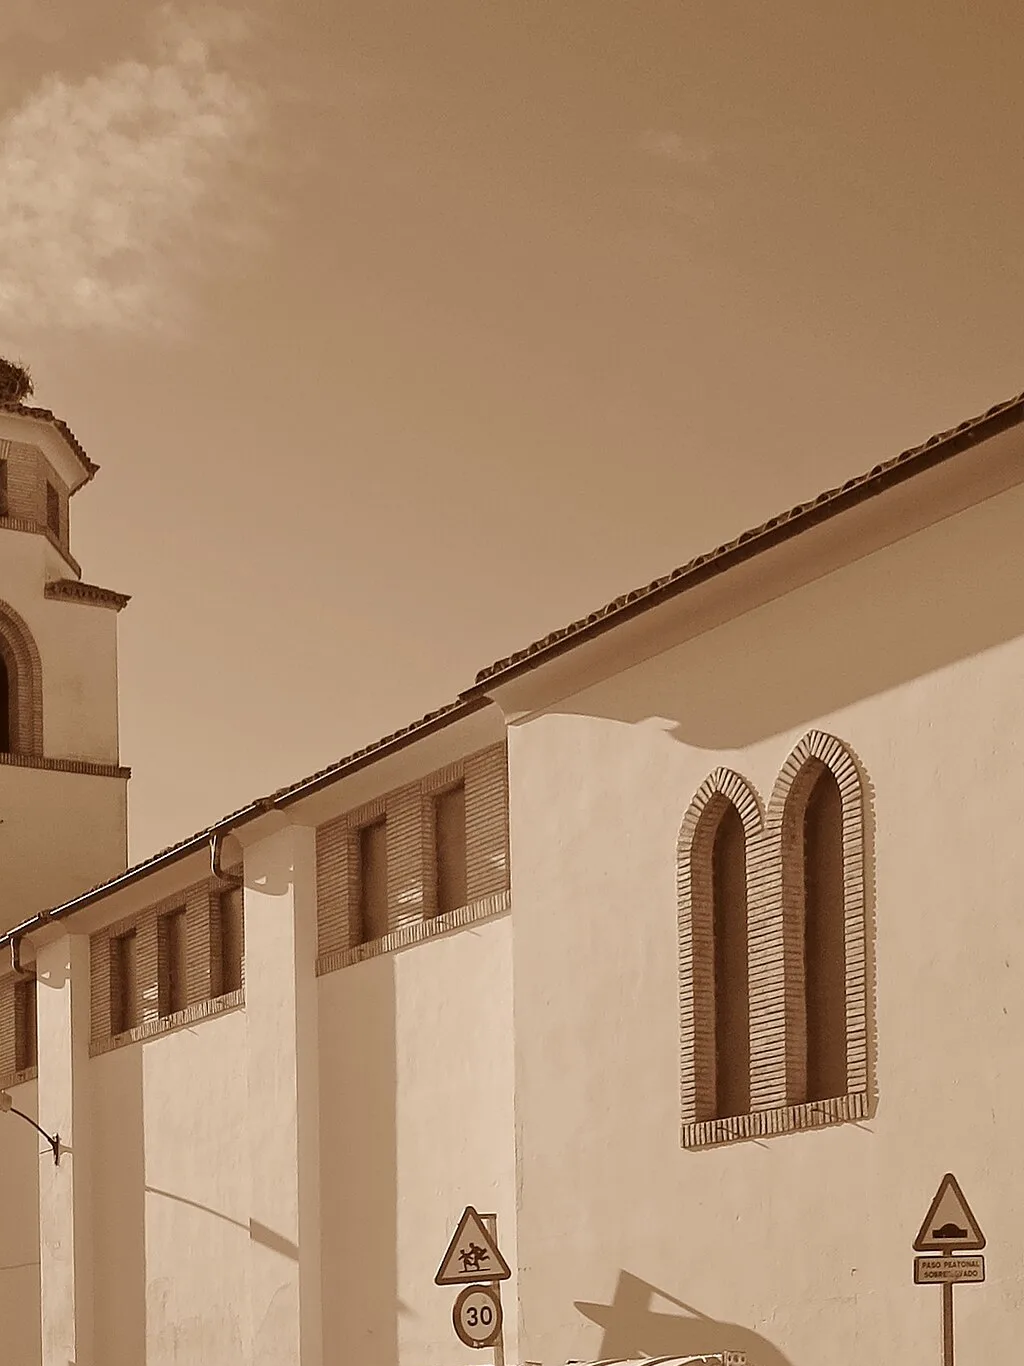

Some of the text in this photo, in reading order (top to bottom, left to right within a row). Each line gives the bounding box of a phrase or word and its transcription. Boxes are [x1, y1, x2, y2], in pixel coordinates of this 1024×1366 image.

[921, 1260, 980, 1269] PASO PEATONAL
[923, 1270, 978, 1278] SOBREVADO
[466, 1306, 492, 1327] 30
